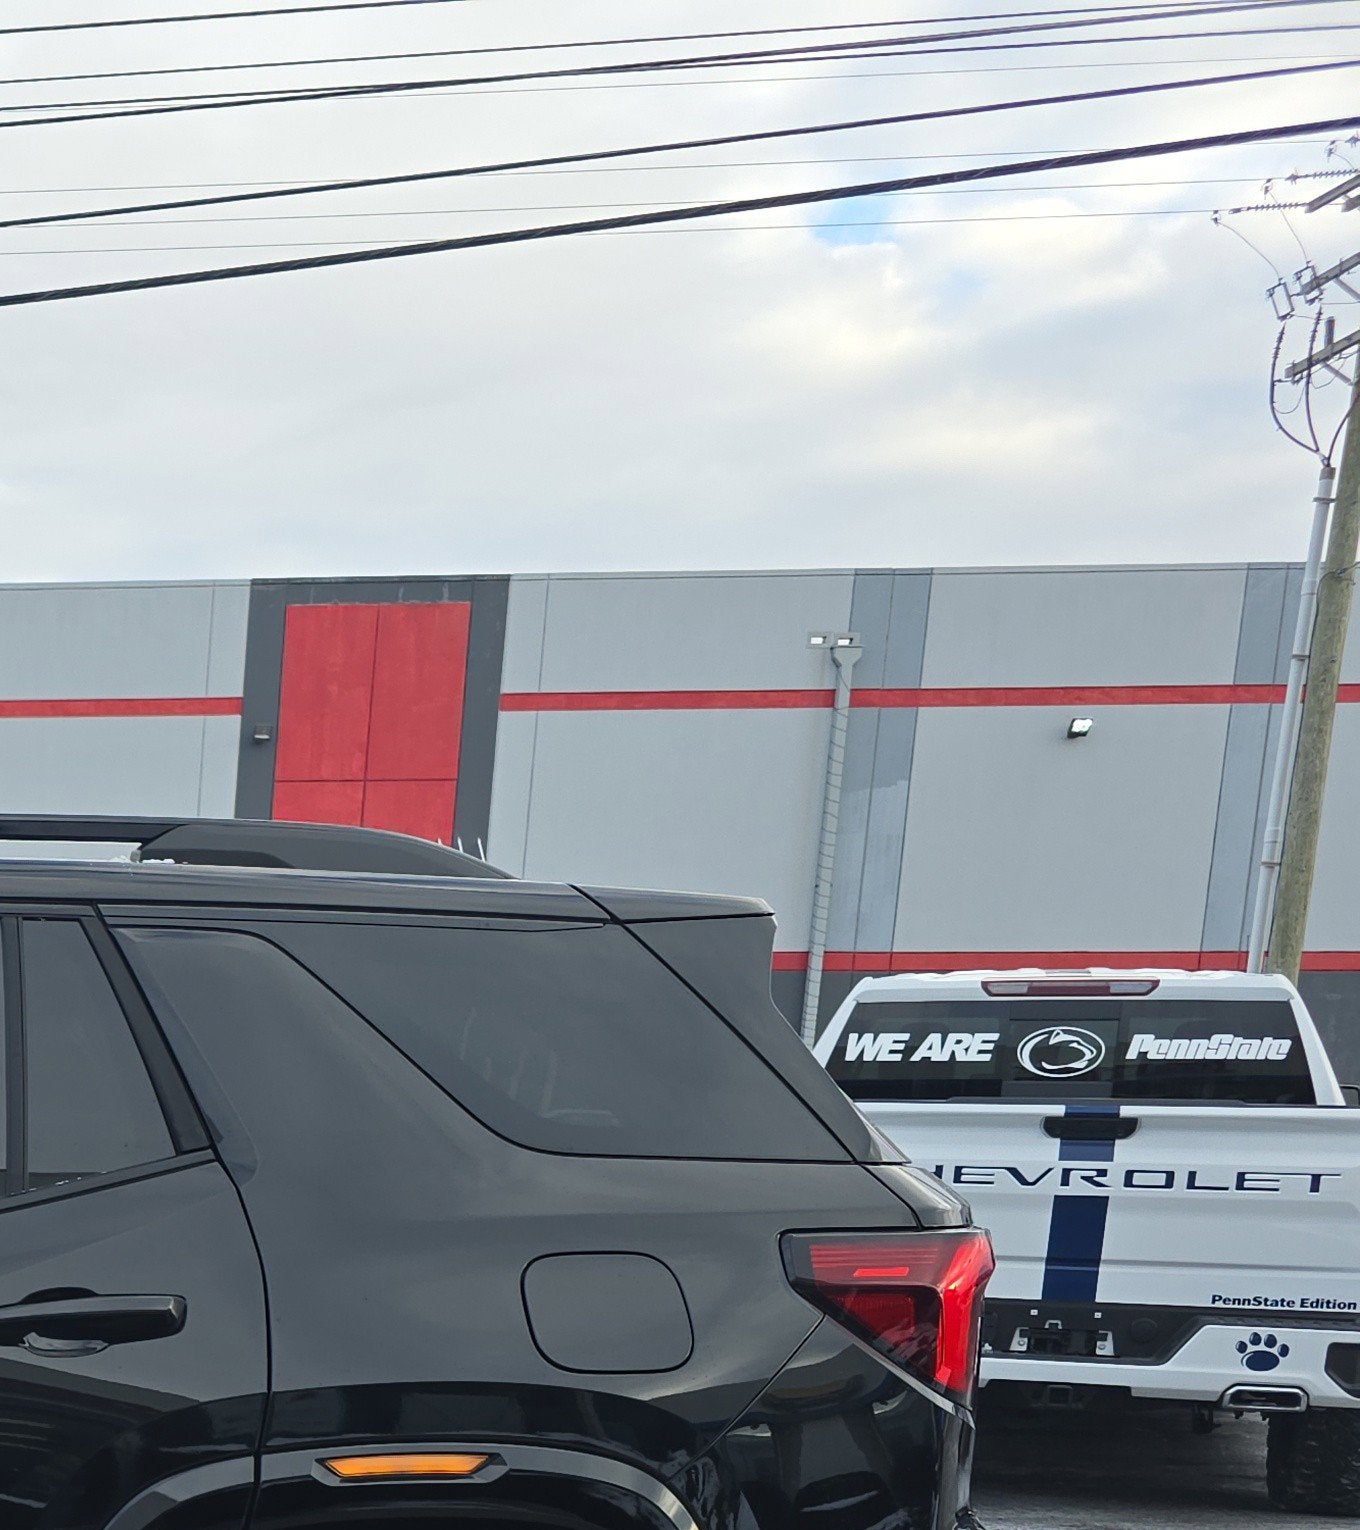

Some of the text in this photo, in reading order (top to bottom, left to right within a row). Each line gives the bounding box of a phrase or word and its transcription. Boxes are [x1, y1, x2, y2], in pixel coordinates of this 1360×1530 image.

[844, 1032, 1293, 1062] WE ARE PennState
[930, 1164, 1342, 1194] EVROLET
[1210, 1293, 1358, 1311] PennState Edition
